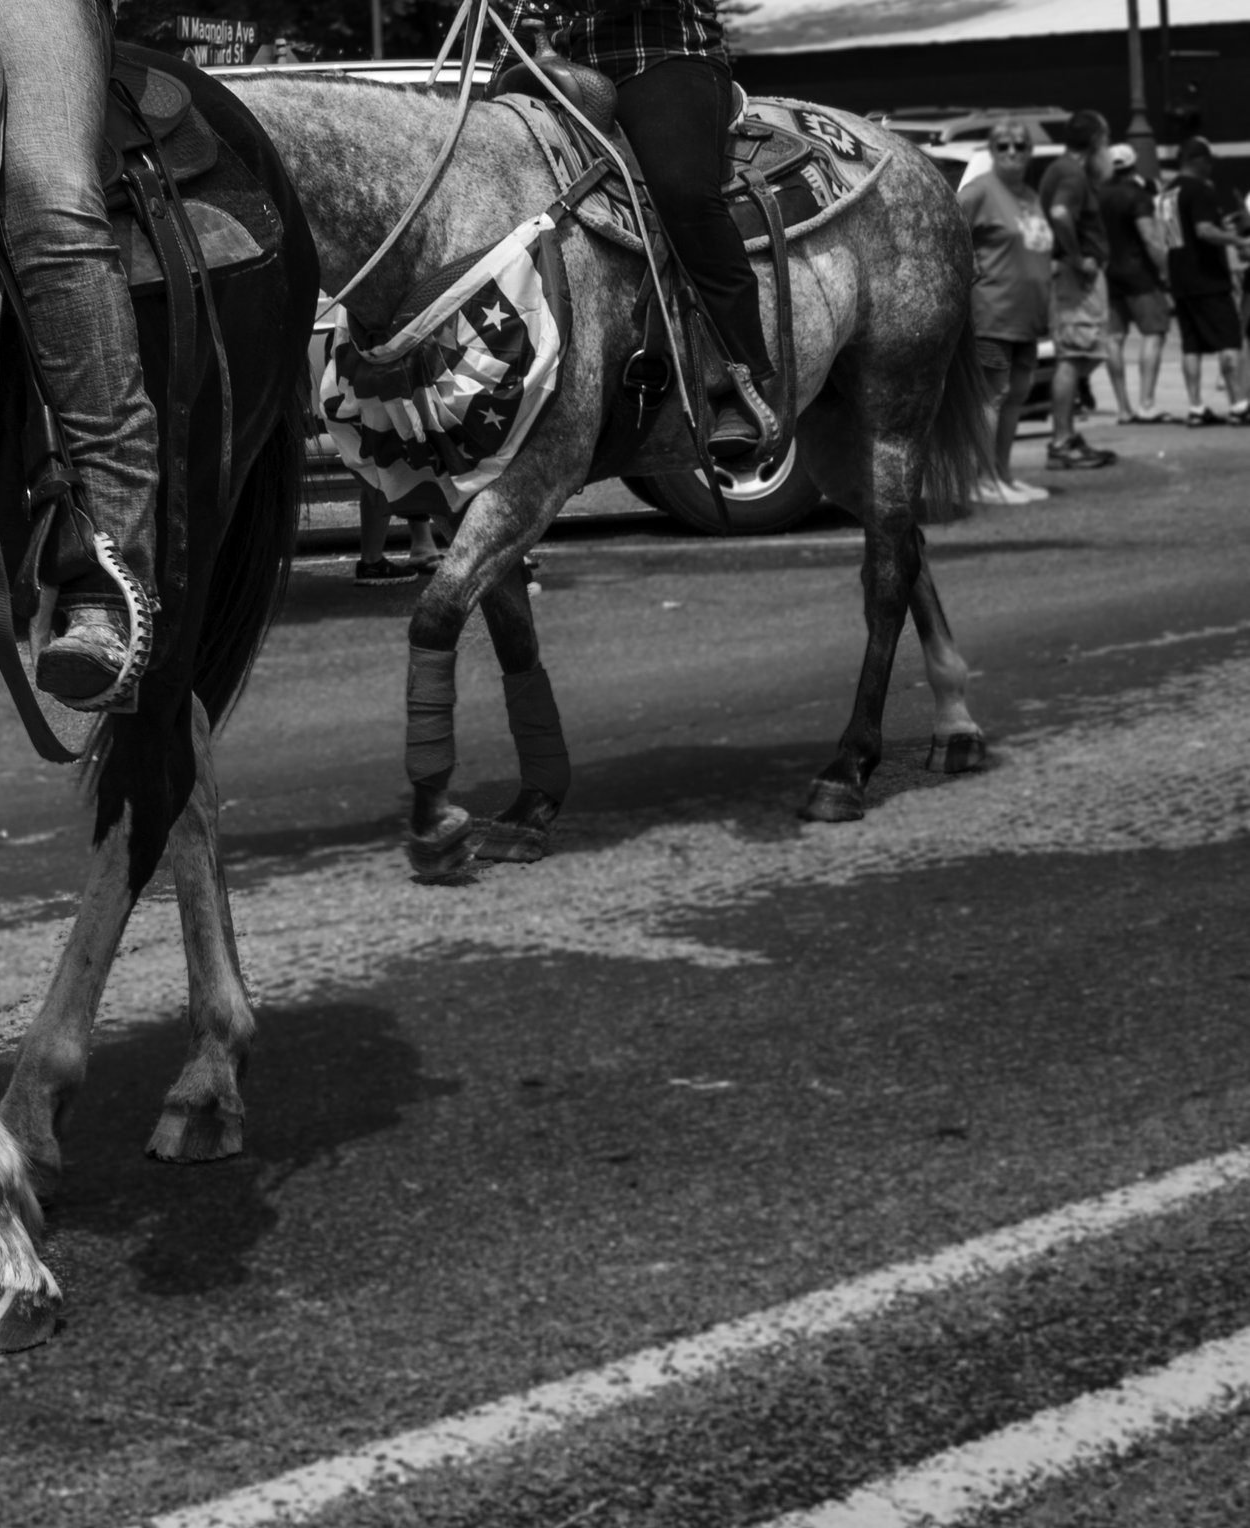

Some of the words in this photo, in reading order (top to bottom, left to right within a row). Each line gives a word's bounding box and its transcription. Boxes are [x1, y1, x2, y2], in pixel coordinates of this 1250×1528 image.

[181, 16, 189, 38] N
[191, 17, 233, 42] Magnolia
[235, 21, 255, 44] Ave
[194, 45, 208, 64] NW
[234, 43, 244, 64] St
